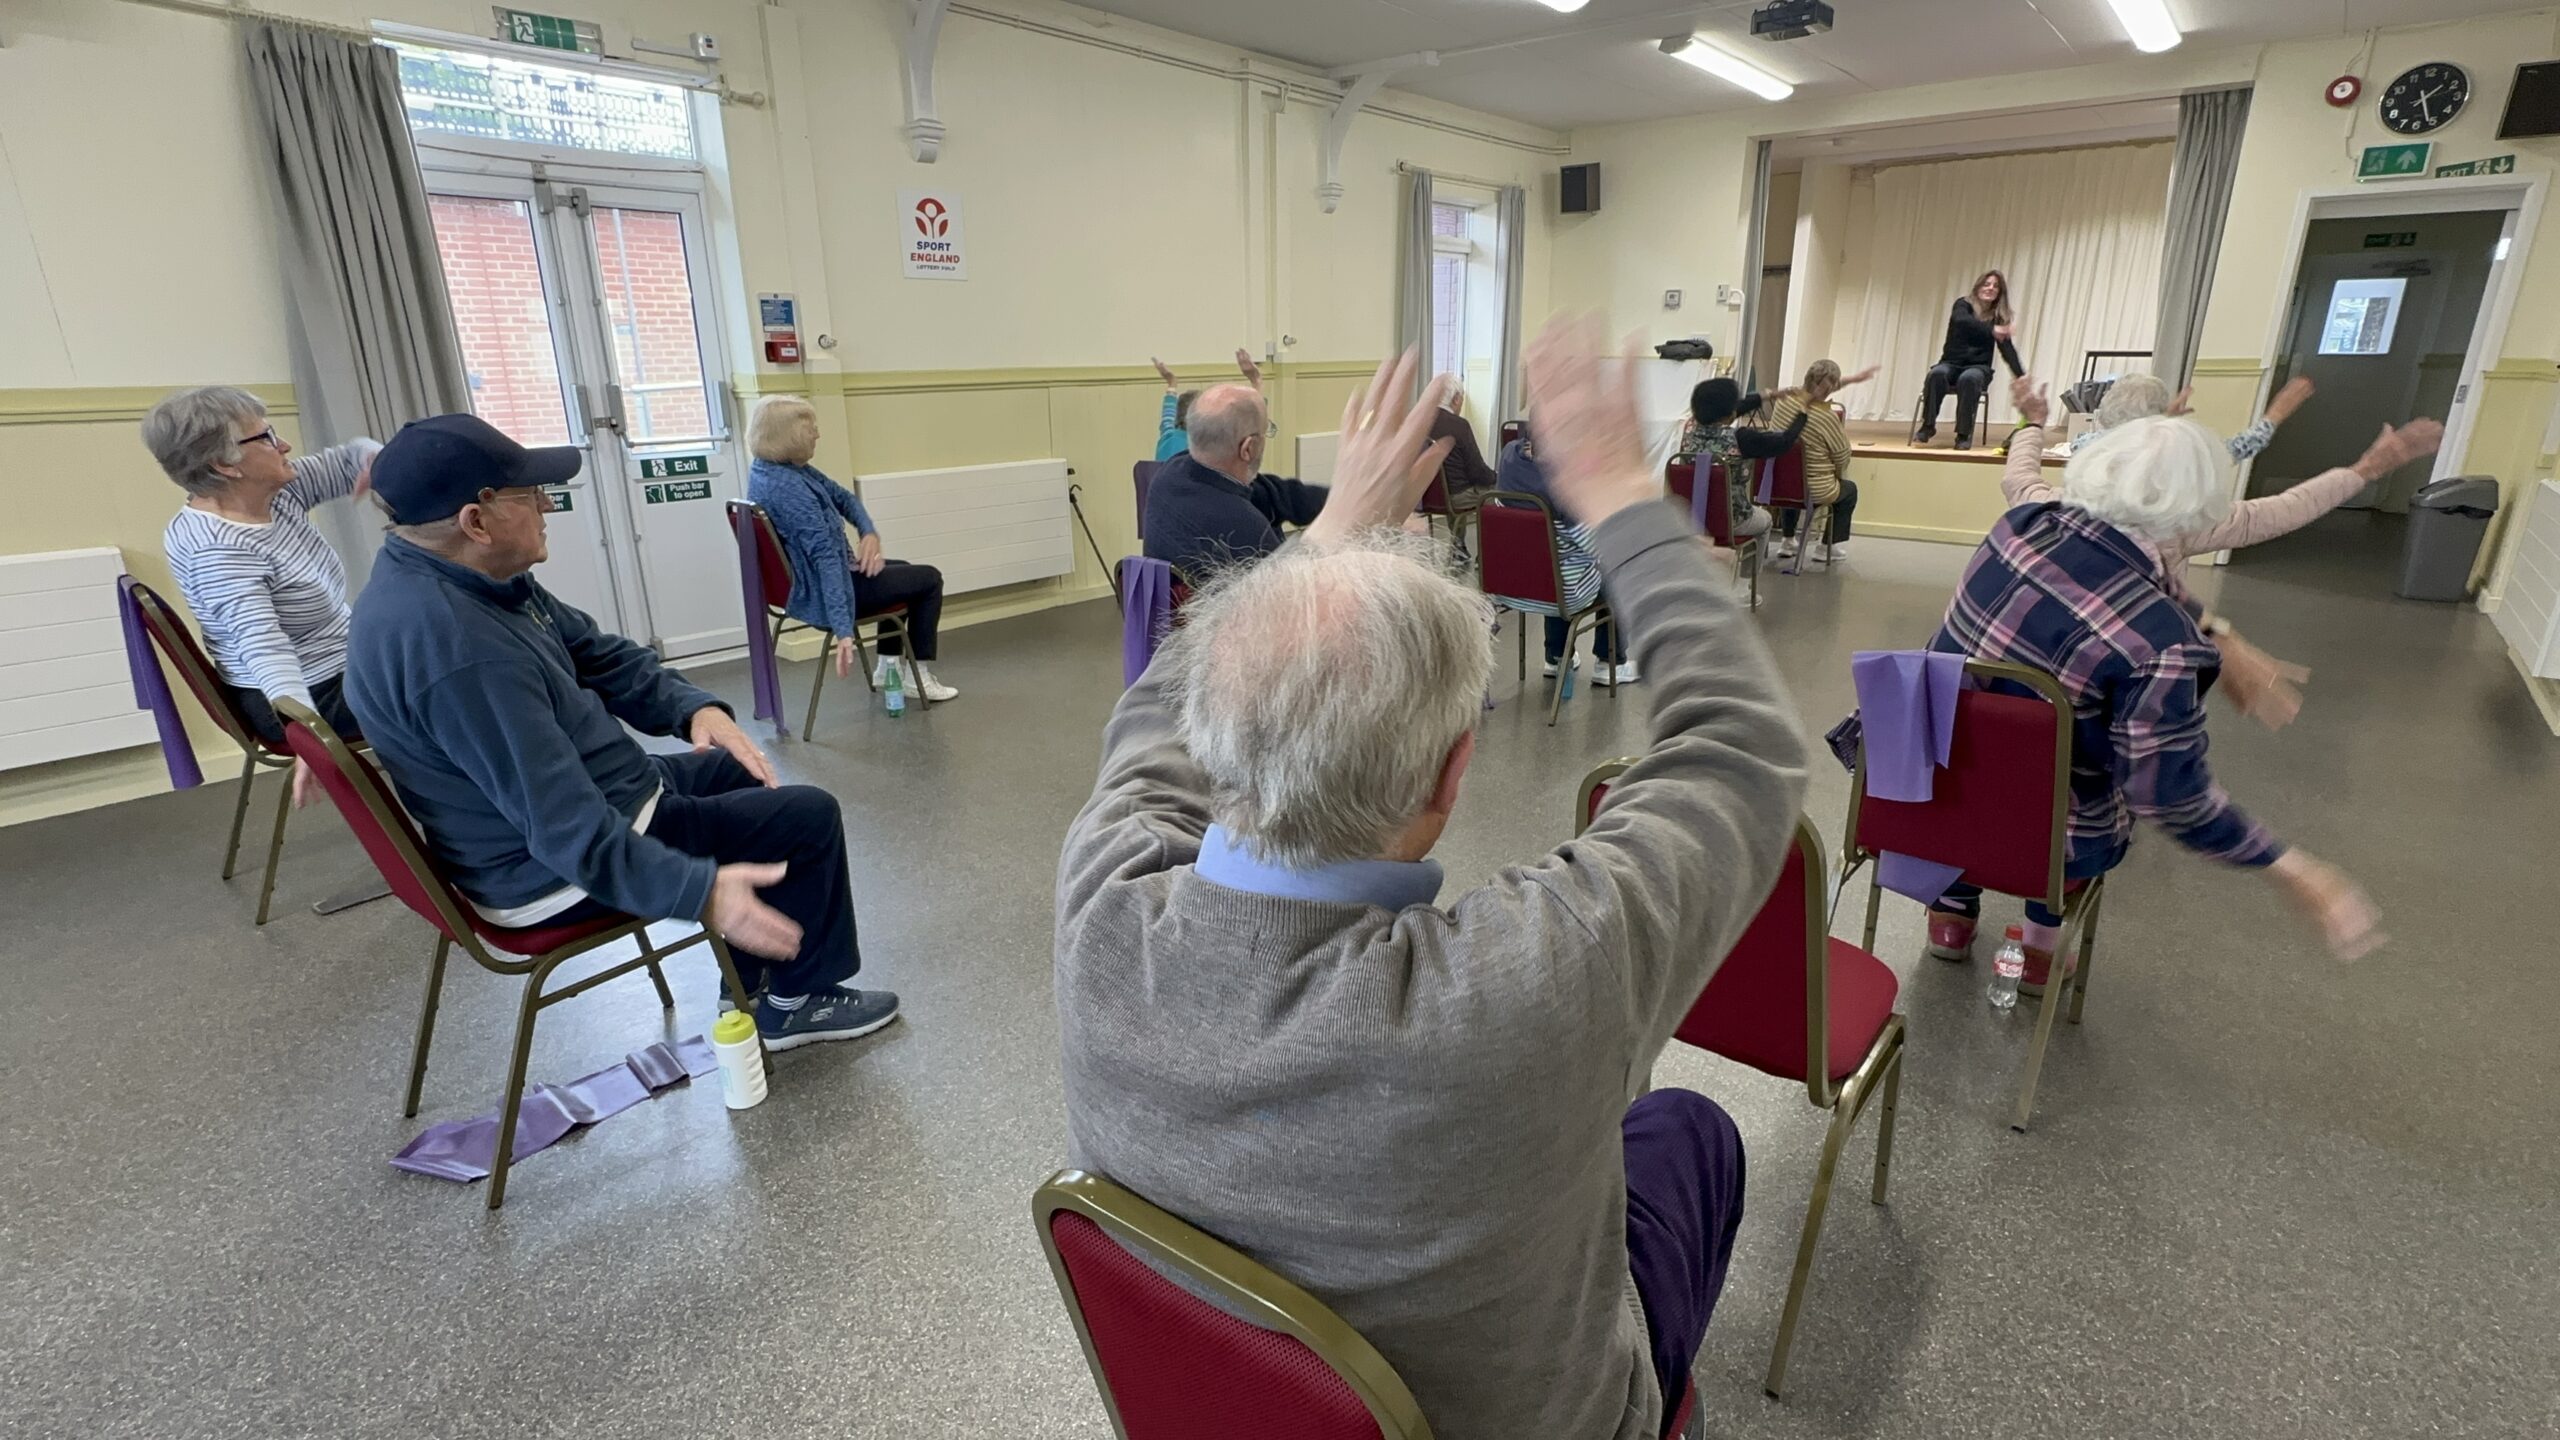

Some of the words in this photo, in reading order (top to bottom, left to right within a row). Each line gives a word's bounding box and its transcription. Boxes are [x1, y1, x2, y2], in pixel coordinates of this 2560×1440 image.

[2425, 67, 2438, 78] 12
[2444, 71, 2449, 80] 1
[2409, 73, 2419, 83] 11
[2449, 80, 2459, 89] 2
[2394, 85, 2406, 95] 10
[2452, 91, 2461, 101] 3
[2385, 97, 2395, 107] 9
[2389, 109, 2399, 119] 8
[2442, 104, 2452, 114] 4
[2400, 119, 2409, 128] 7
[2411, 120, 2421, 130] 6
[2428, 116, 2438, 126] 5
[2440, 167, 2469, 178] EXIT
[916, 241, 952, 251] SPORT
[910, 252, 960, 264] ENGLAND
[674, 460, 698, 472] Exit
[670, 483, 690, 492] Push
[691, 482, 705, 490] bar
[674, 491, 683, 499] to
[684, 490, 704, 499] open
